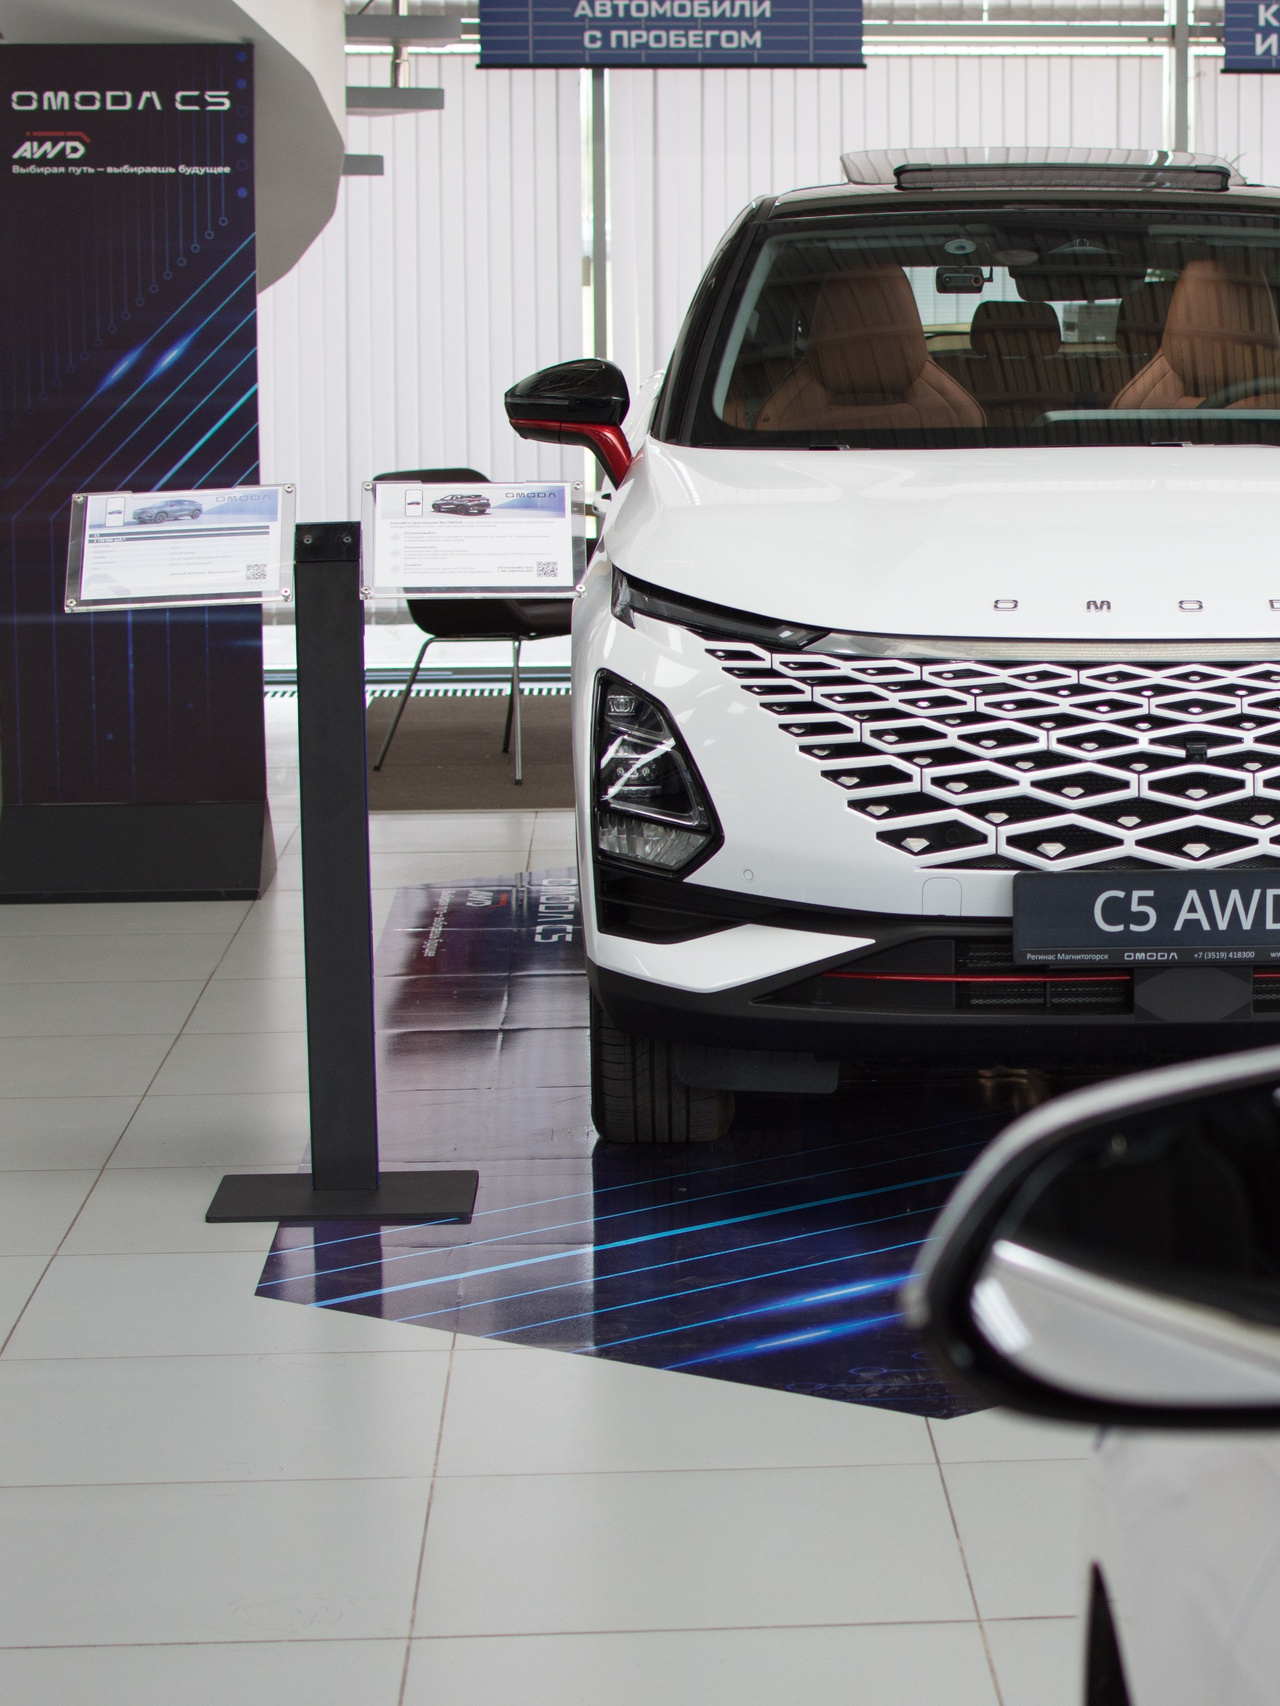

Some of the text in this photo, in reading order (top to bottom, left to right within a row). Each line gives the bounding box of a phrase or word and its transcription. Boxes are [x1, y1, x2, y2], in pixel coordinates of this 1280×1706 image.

[573, 0, 772, 18] АВТОМОБИЛИ
[583, 30, 762, 49] С ПРОБЕГОМ
[1255, 33, 1279, 56] И
[11, 91, 162, 111] OMODA
[12, 140, 86, 160] AWD
[12, 165, 65, 175] Выбирая
[68, 166, 95, 175] путь
[106, 165, 176, 175] выбираешь
[178, 164, 231, 175] будущее
[215, 494, 272, 503] OMODA
[1094, 890, 1157, 932] C5
[1026, 953, 1056, 961] Регинас
[1057, 953, 1109, 961] Магнитогорск
[1124, 952, 1178, 961] OMODA
[1204, 951, 1227, 960] (3519)
[1228, 951, 1255, 959] 418300
